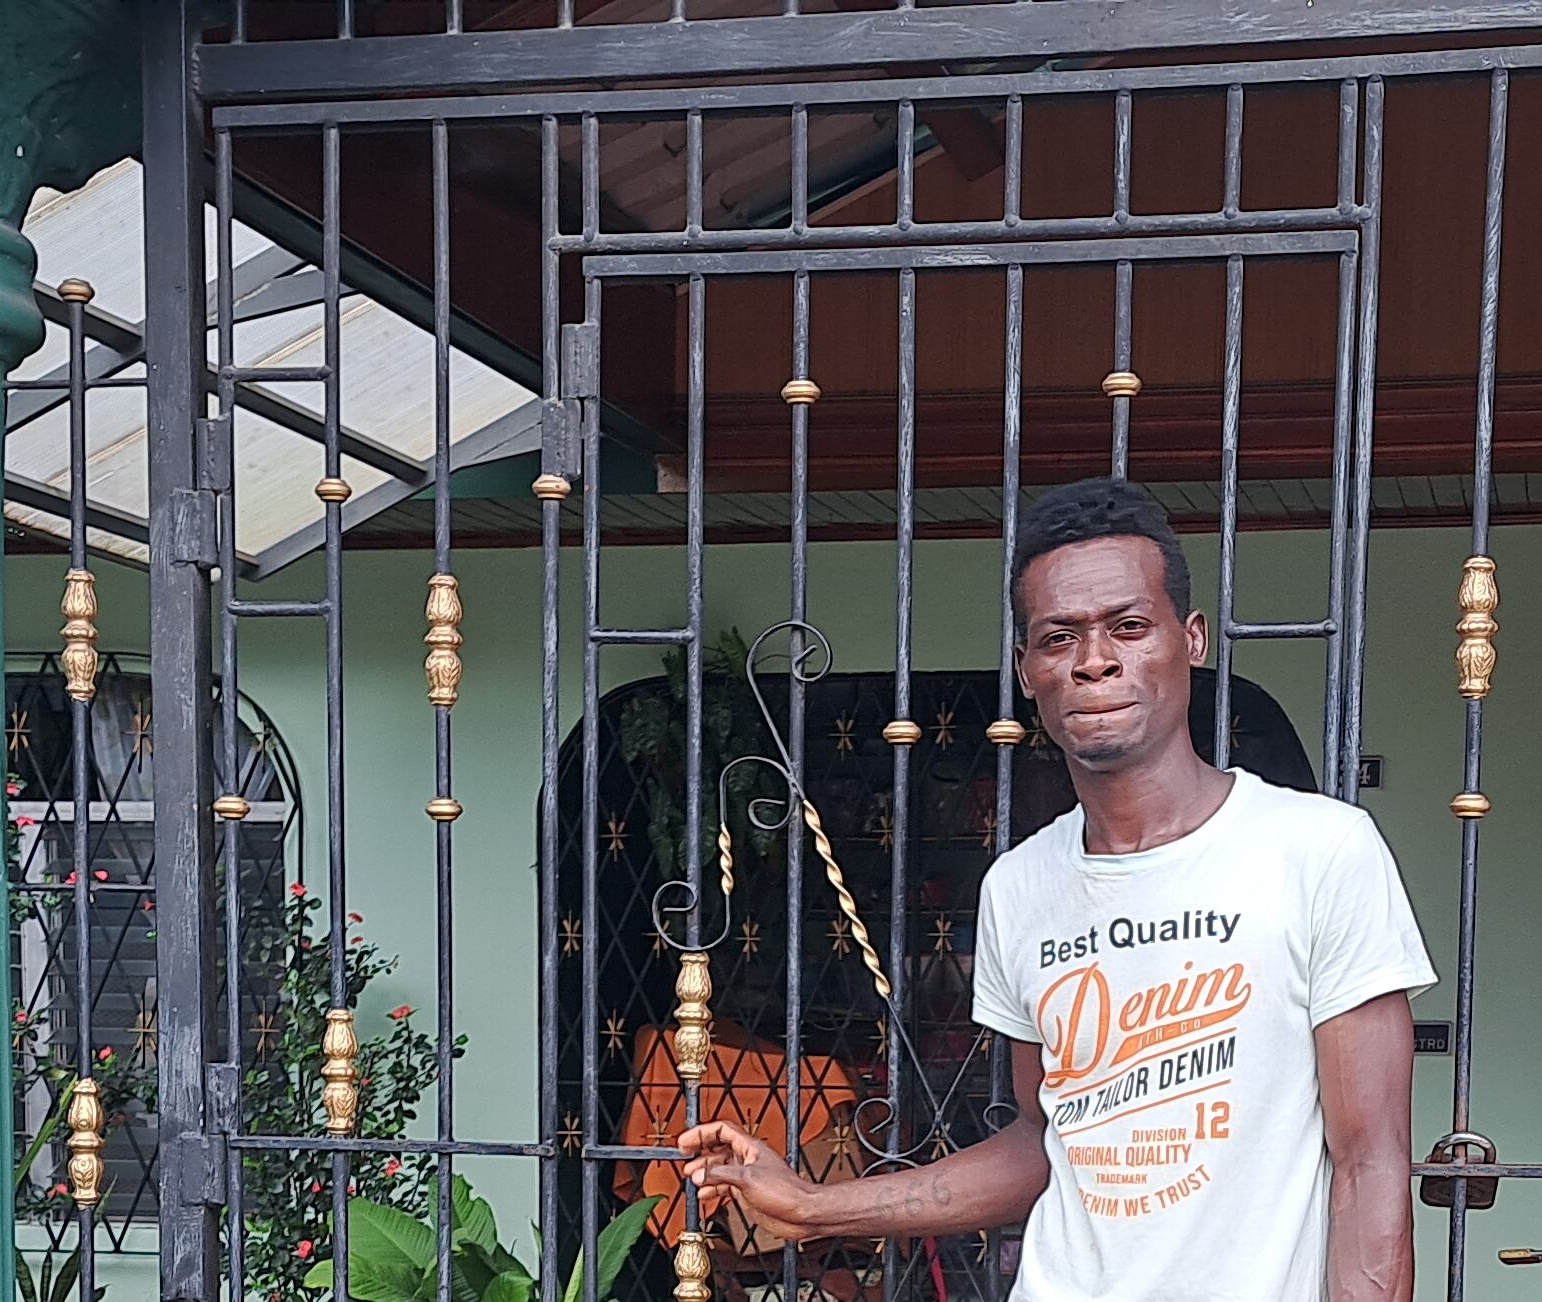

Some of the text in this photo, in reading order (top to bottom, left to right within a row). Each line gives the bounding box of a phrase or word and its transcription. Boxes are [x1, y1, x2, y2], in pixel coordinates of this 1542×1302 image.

[1039, 910, 1242, 969] Best Quality
[1037, 961, 1251, 1088] Denim
[1052, 1036, 1236, 1128] TOM TAILOR DENIM
[1131, 1101, 1231, 1144] DIVISION 12
[1067, 1143, 1192, 1168] ORIGINAL QUALITY
[1095, 1172, 1148, 1185] TRADEMARK
[1124, 1195, 1152, 1217] WE
[1154, 1163, 1211, 1209] TRUST
